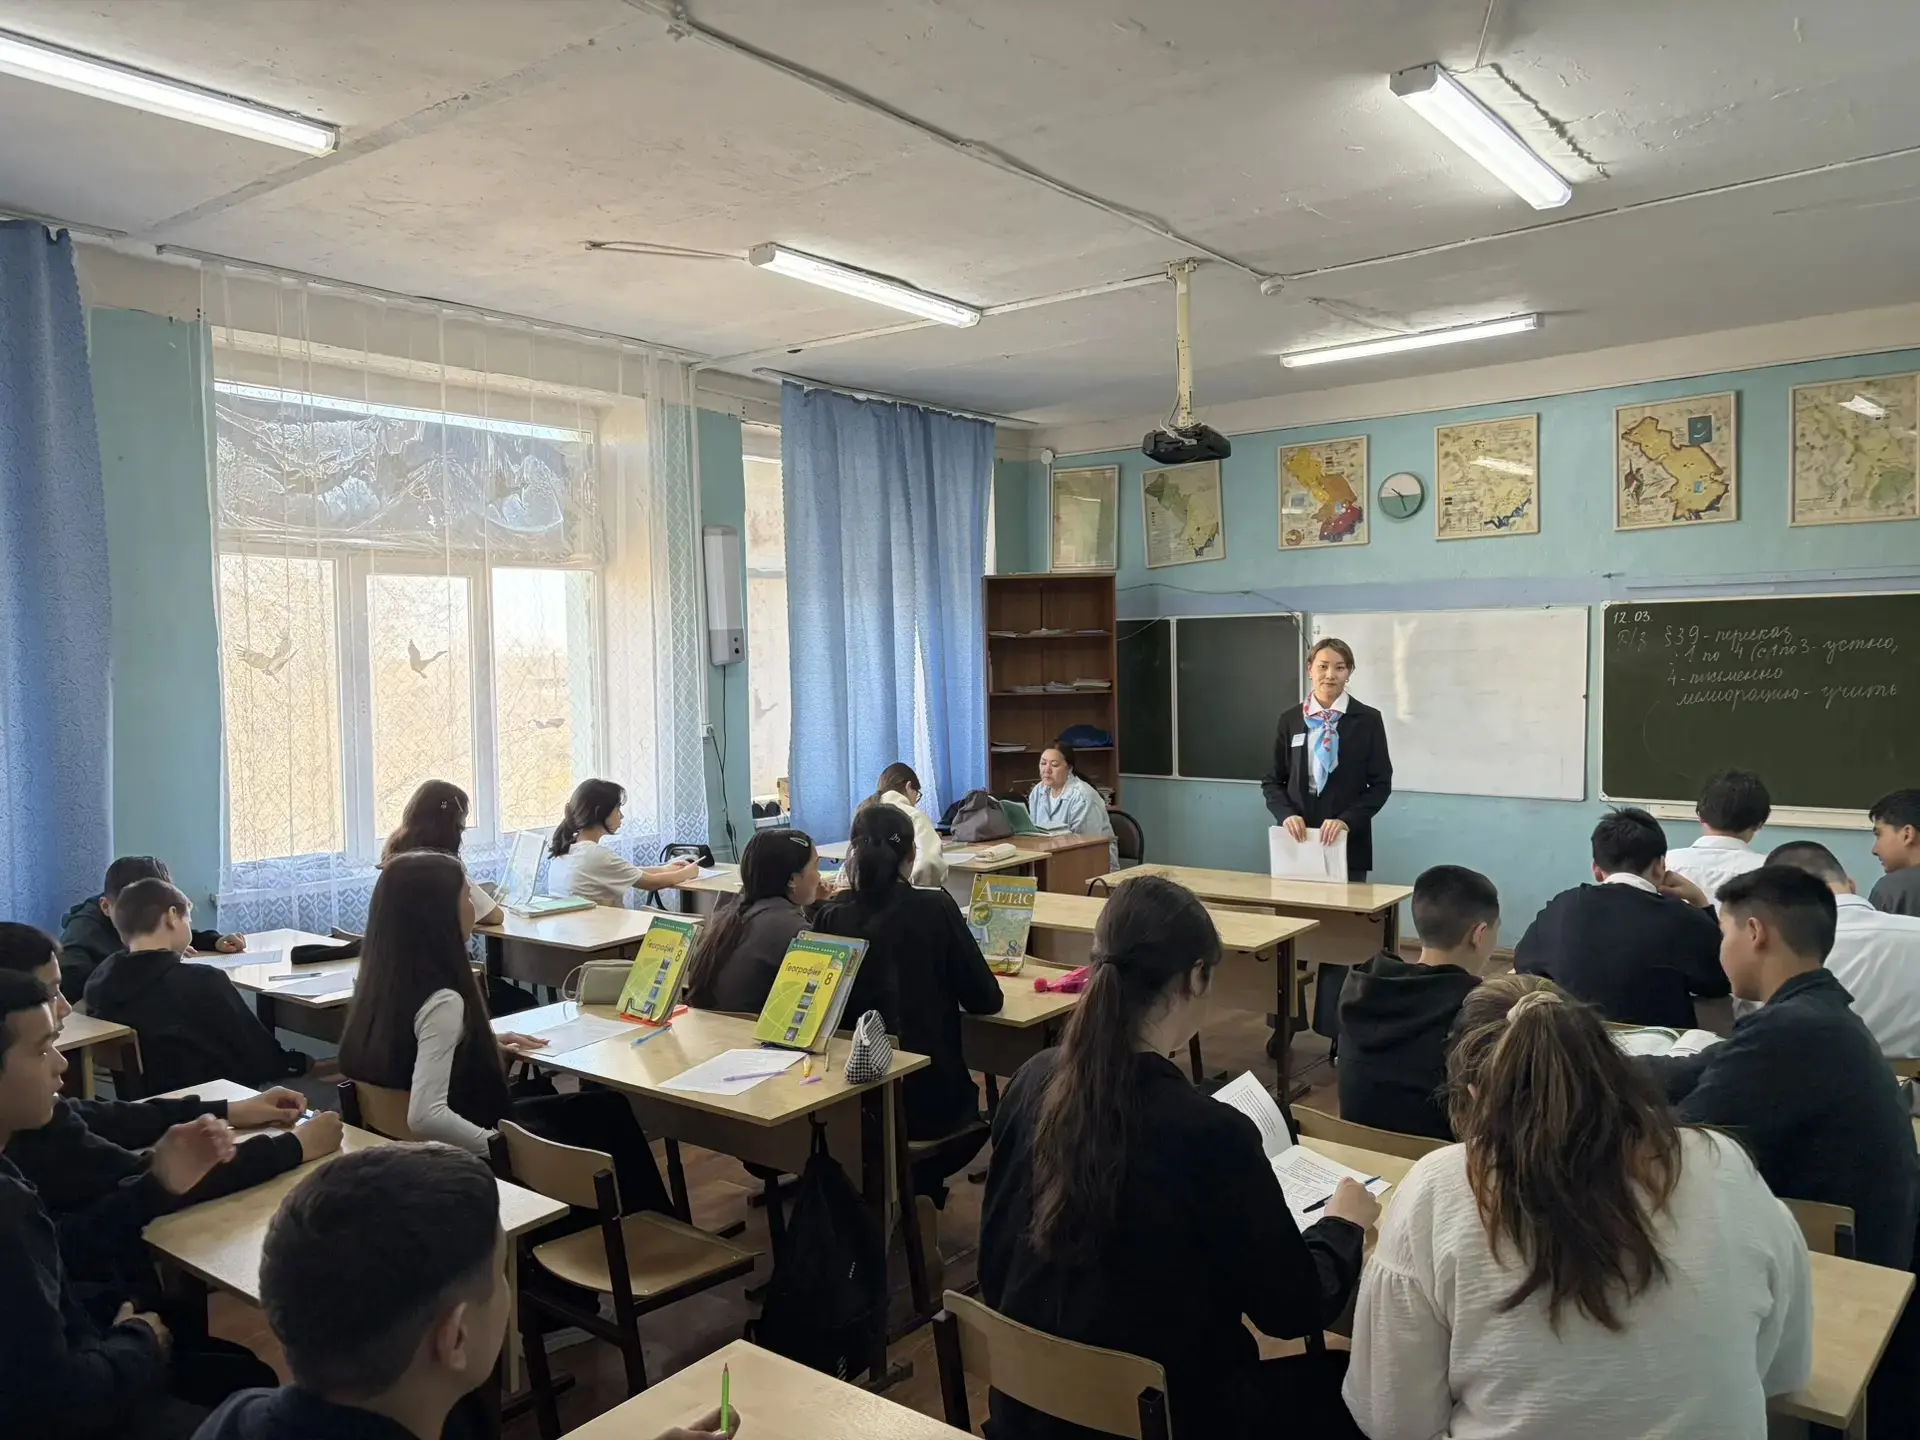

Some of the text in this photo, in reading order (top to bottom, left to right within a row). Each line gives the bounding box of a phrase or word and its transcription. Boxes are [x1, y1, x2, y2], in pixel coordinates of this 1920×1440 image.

[1702, 651, 1720, 662] по
[1733, 642, 1744, 659] 4
[1689, 667, 1783, 684] письменно
[1820, 683, 1898, 711] учить
[674, 949, 683, 962] 8
[1006, 939, 1018, 957] 8
[784, 962, 822, 977] География
[824, 972, 834, 986] 8
